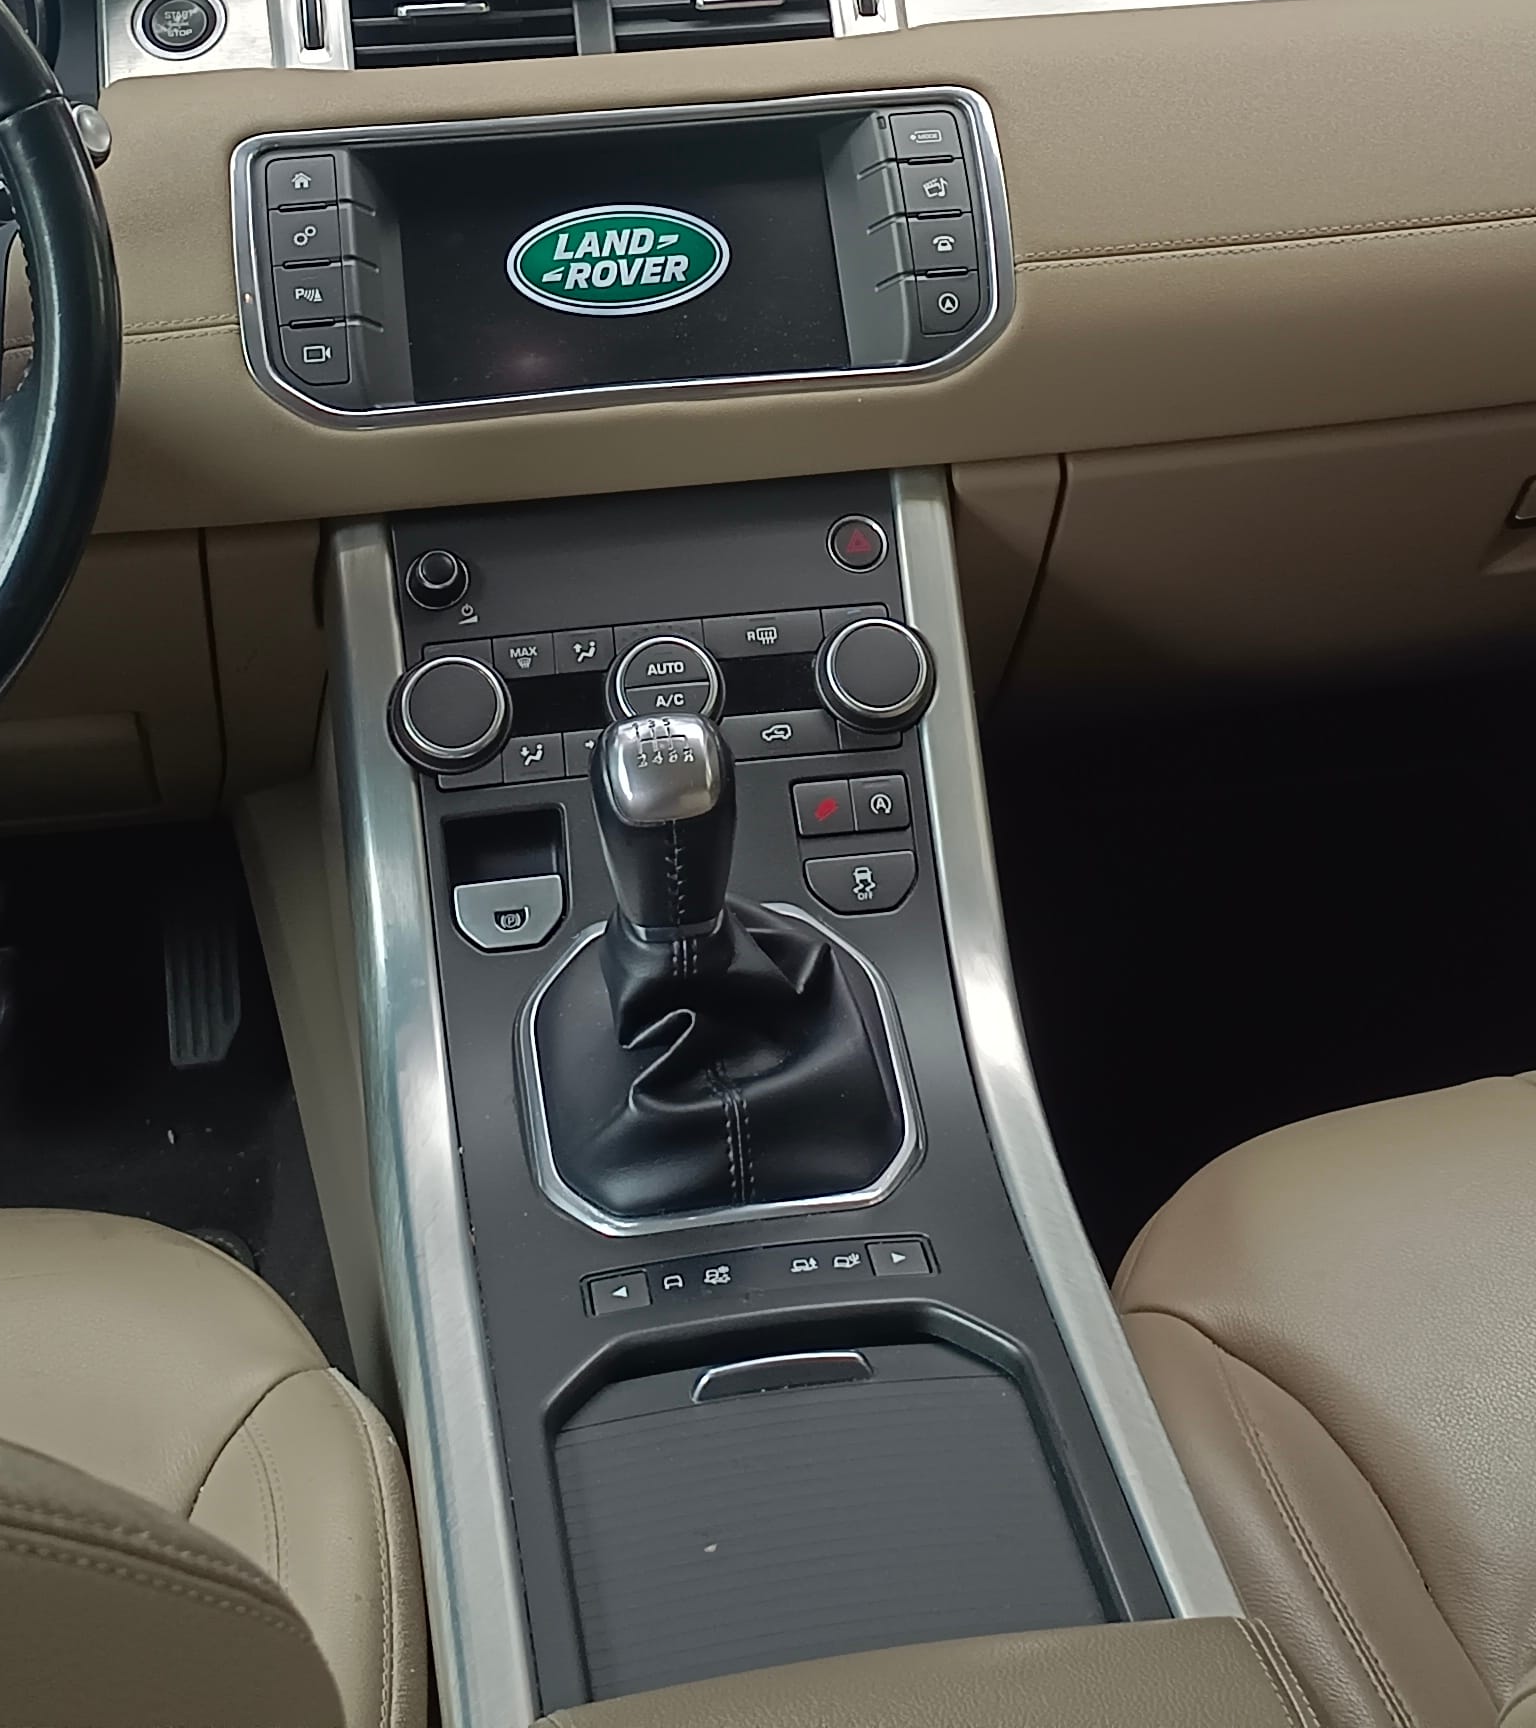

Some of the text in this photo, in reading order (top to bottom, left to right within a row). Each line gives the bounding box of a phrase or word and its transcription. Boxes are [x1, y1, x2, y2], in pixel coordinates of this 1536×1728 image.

[553, 227, 655, 261] LAND
[564, 254, 689, 291] ROVER
[509, 646, 538, 659] MAX
[647, 661, 685, 676] AUTO
[655, 693, 685, 708] A/C
